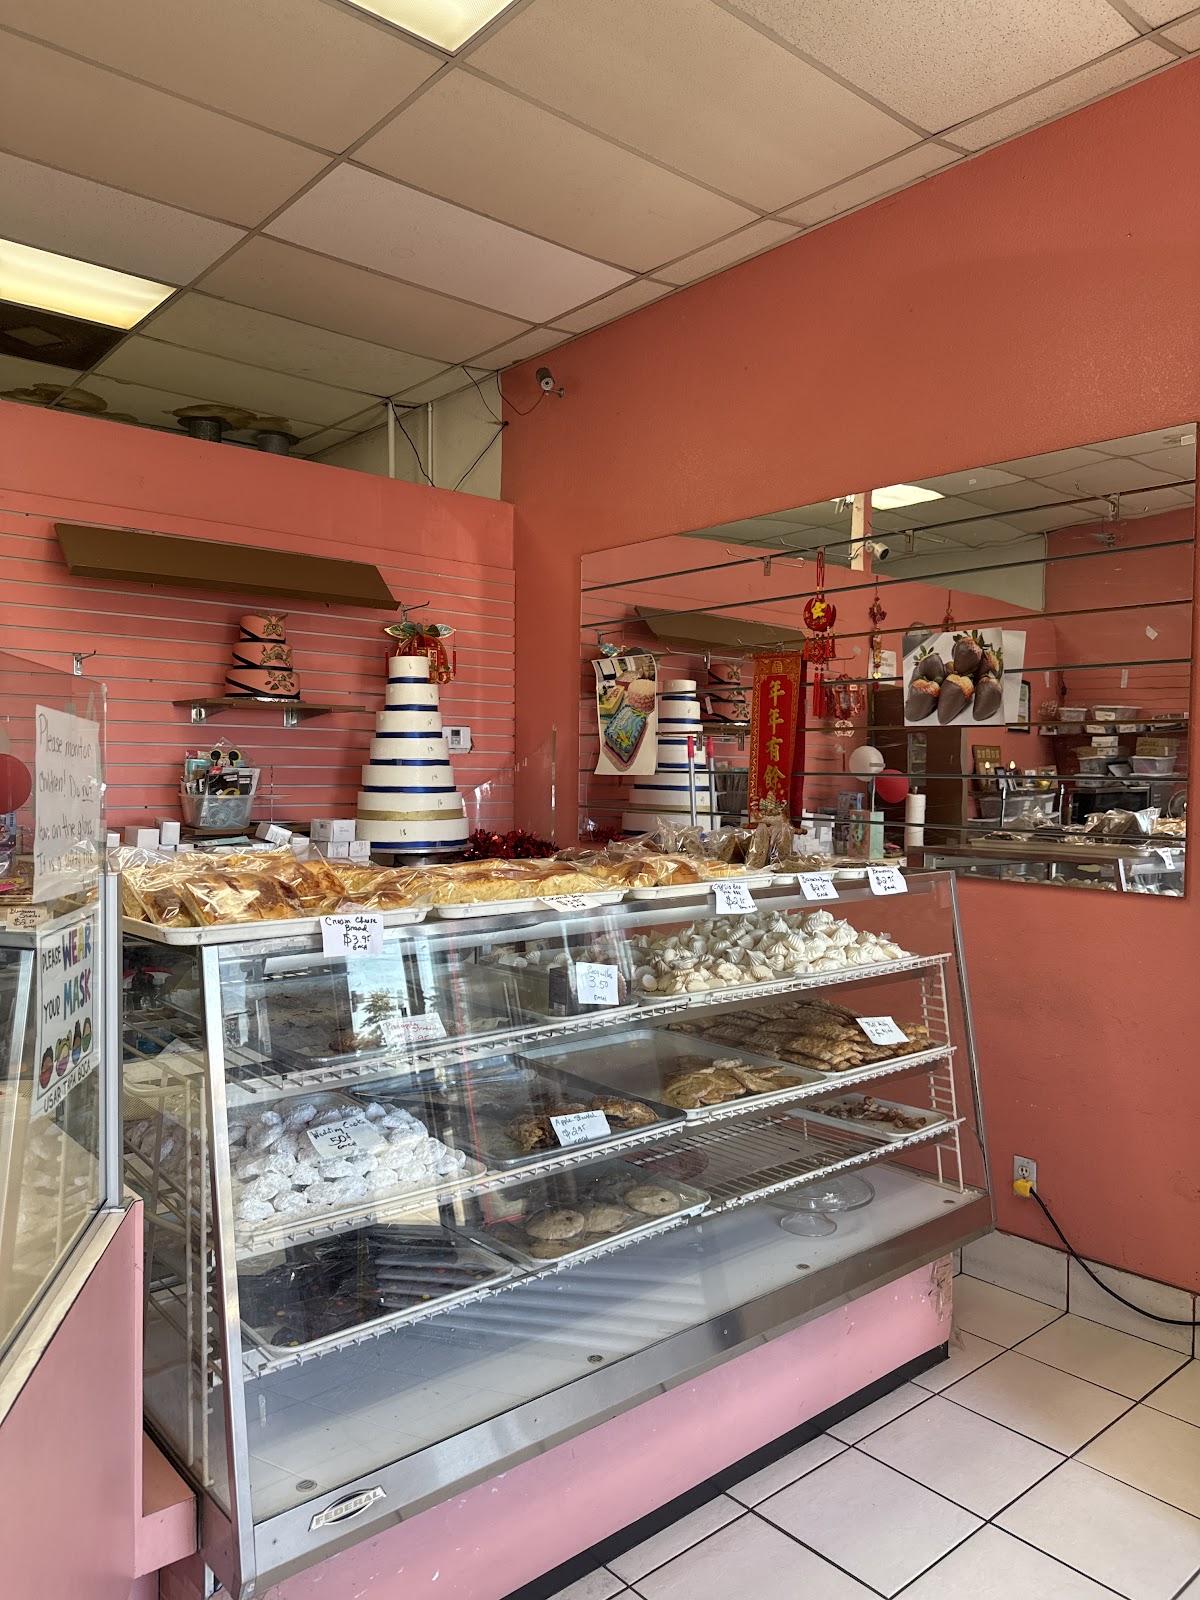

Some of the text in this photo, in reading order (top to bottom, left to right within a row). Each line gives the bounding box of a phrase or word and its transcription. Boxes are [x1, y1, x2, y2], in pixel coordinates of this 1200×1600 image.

[39, 713, 92, 760] Please monitor
[763, 680, 786, 790] 年年有餘
[51, 823, 61, 840] on
[62, 813, 76, 839] the
[324, 916, 352, 926] Cream
[42, 922, 92, 974] PLEASE WEAR
[43, 967, 92, 1024] YOUR MASK
[589, 975, 609, 990] 3.50
[43, 1058, 91, 1113] USAR TAPA BOCA
[310, 1126, 345, 1140] Wedding
[315, 1490, 381, 1526] FEDERAL
